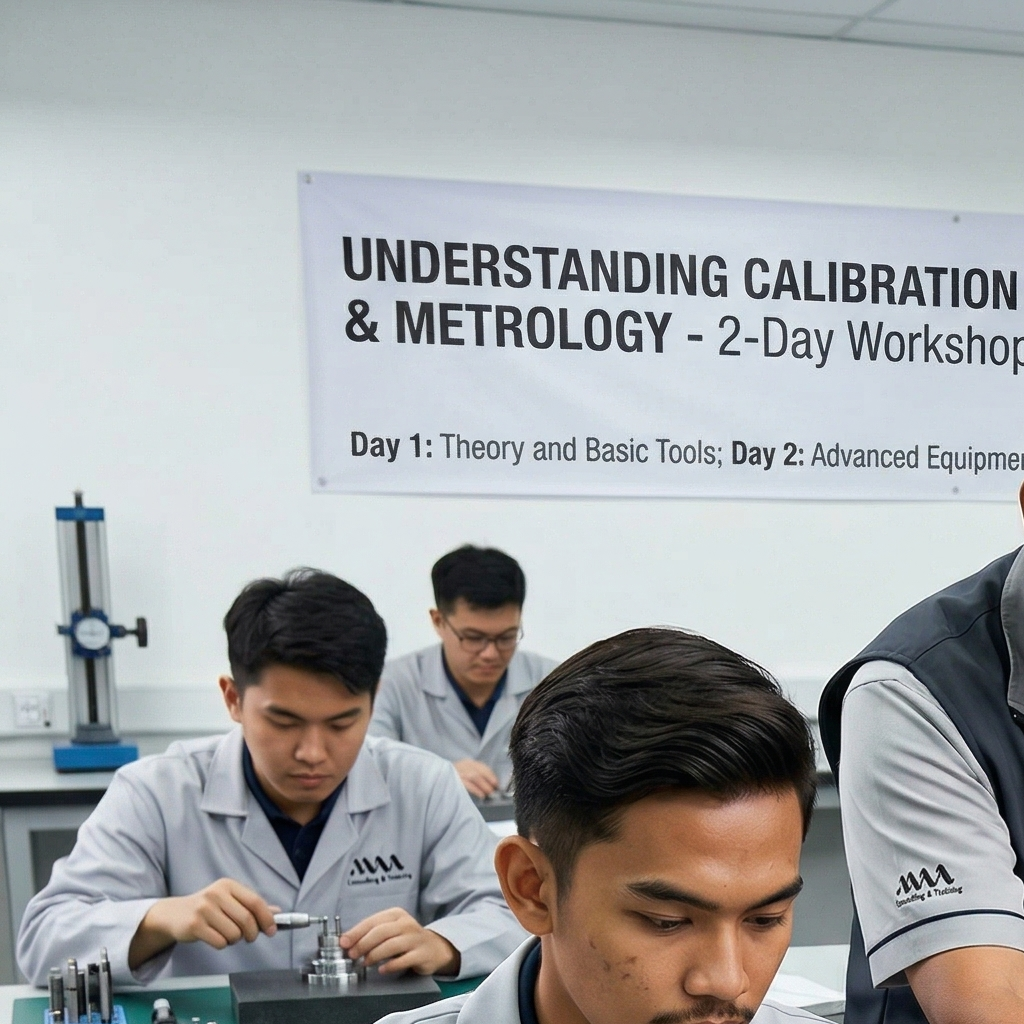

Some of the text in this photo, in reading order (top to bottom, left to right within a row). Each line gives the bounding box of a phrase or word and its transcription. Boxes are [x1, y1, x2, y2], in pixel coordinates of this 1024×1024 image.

[342, 236, 728, 298] UNDERSTANDING
[744, 257, 1018, 311] CALIBRATION
[345, 298, 380, 343] &
[395, 300, 673, 354] METROLOGY
[718, 315, 835, 369] 2-Day
[350, 431, 401, 463] Day
[409, 432, 432, 458] 1:
[439, 433, 525, 466] Theory
[533, 436, 577, 462] and
[585, 436, 649, 464] Basic
[655, 438, 723, 469] Tools;
[732, 440, 777, 471] Day
[783, 441, 804, 467] 2:
[810, 442, 919, 469] Advanced
